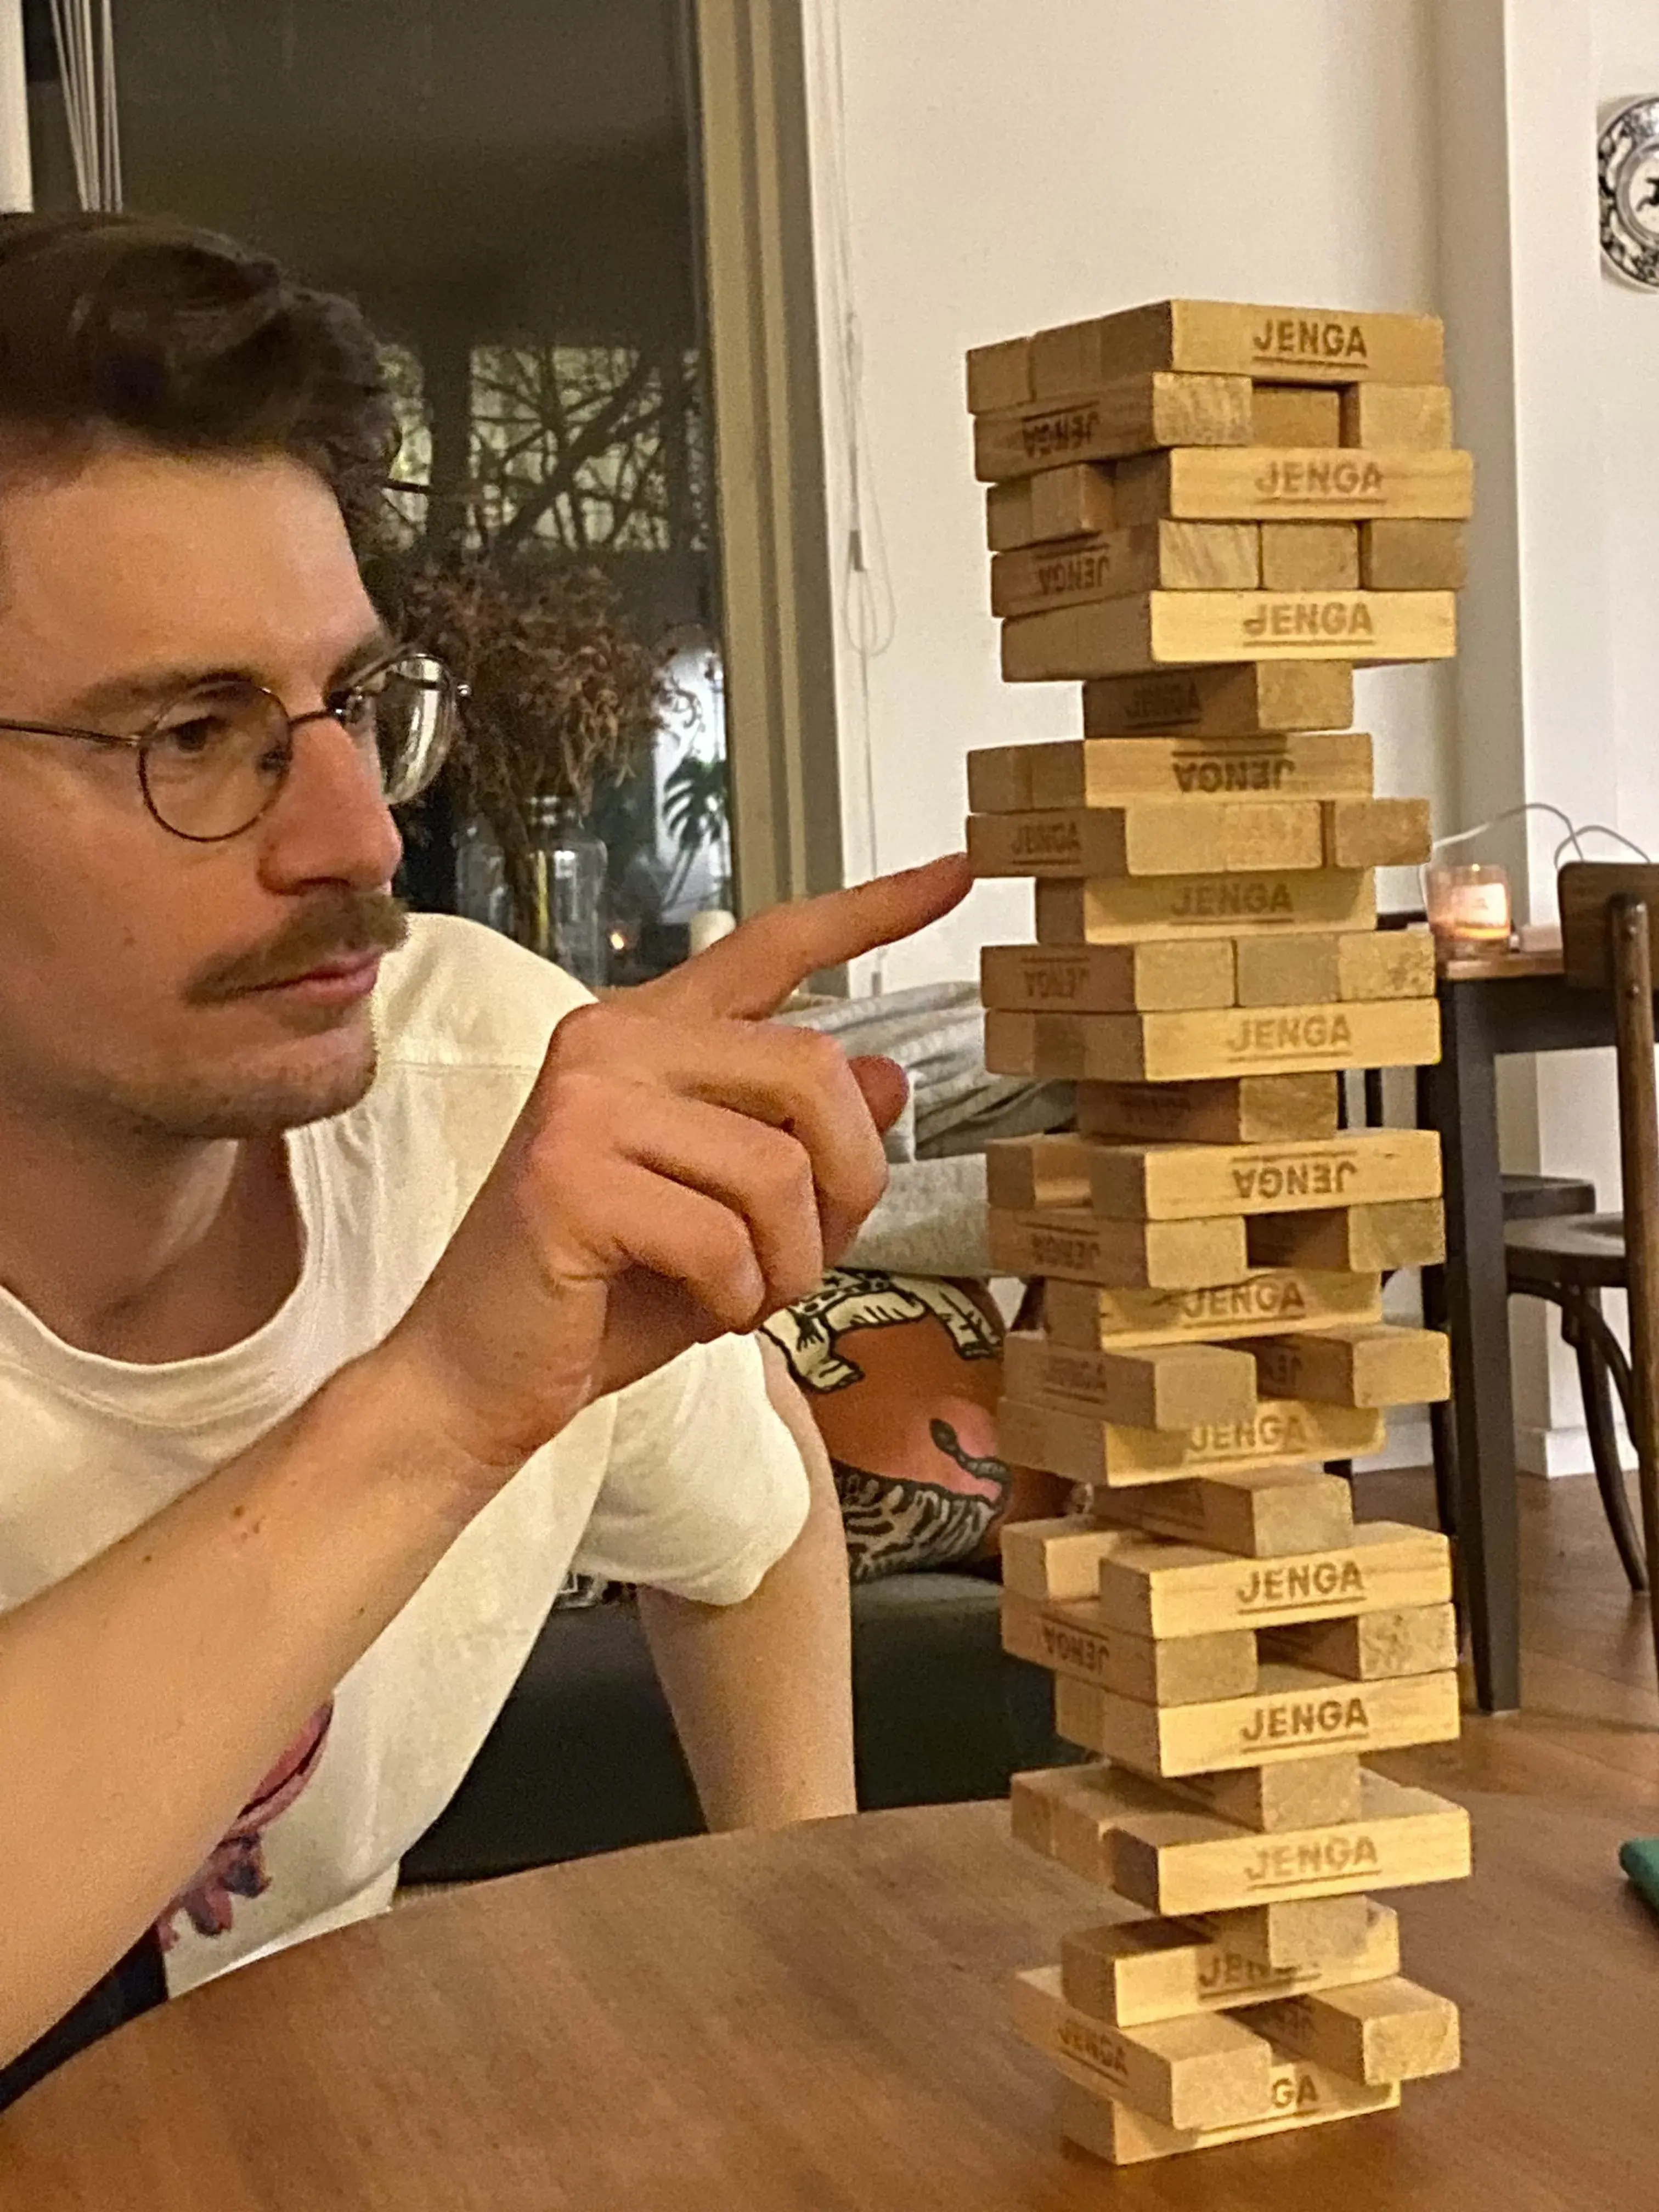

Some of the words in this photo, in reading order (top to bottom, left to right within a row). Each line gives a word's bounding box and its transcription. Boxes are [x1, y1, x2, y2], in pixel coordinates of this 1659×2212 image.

[1252, 319, 1368, 357] JENGA
[1255, 459, 1384, 495] JENGA
[1243, 602, 1373, 635] JENGA
[1173, 760, 1296, 793] JENGA
[1171, 882, 1294, 914] JENGA
[1228, 1015, 1351, 1051] JENGA
[1232, 1160, 1358, 1198] JENGA
[1184, 1280, 1306, 1317] JENGA
[1190, 1414, 1308, 1453] JENGA
[1238, 1561, 1364, 1604] JENGA
[1241, 1698, 1369, 1740] JENGA
[1245, 1835, 1378, 1881] JENGA
